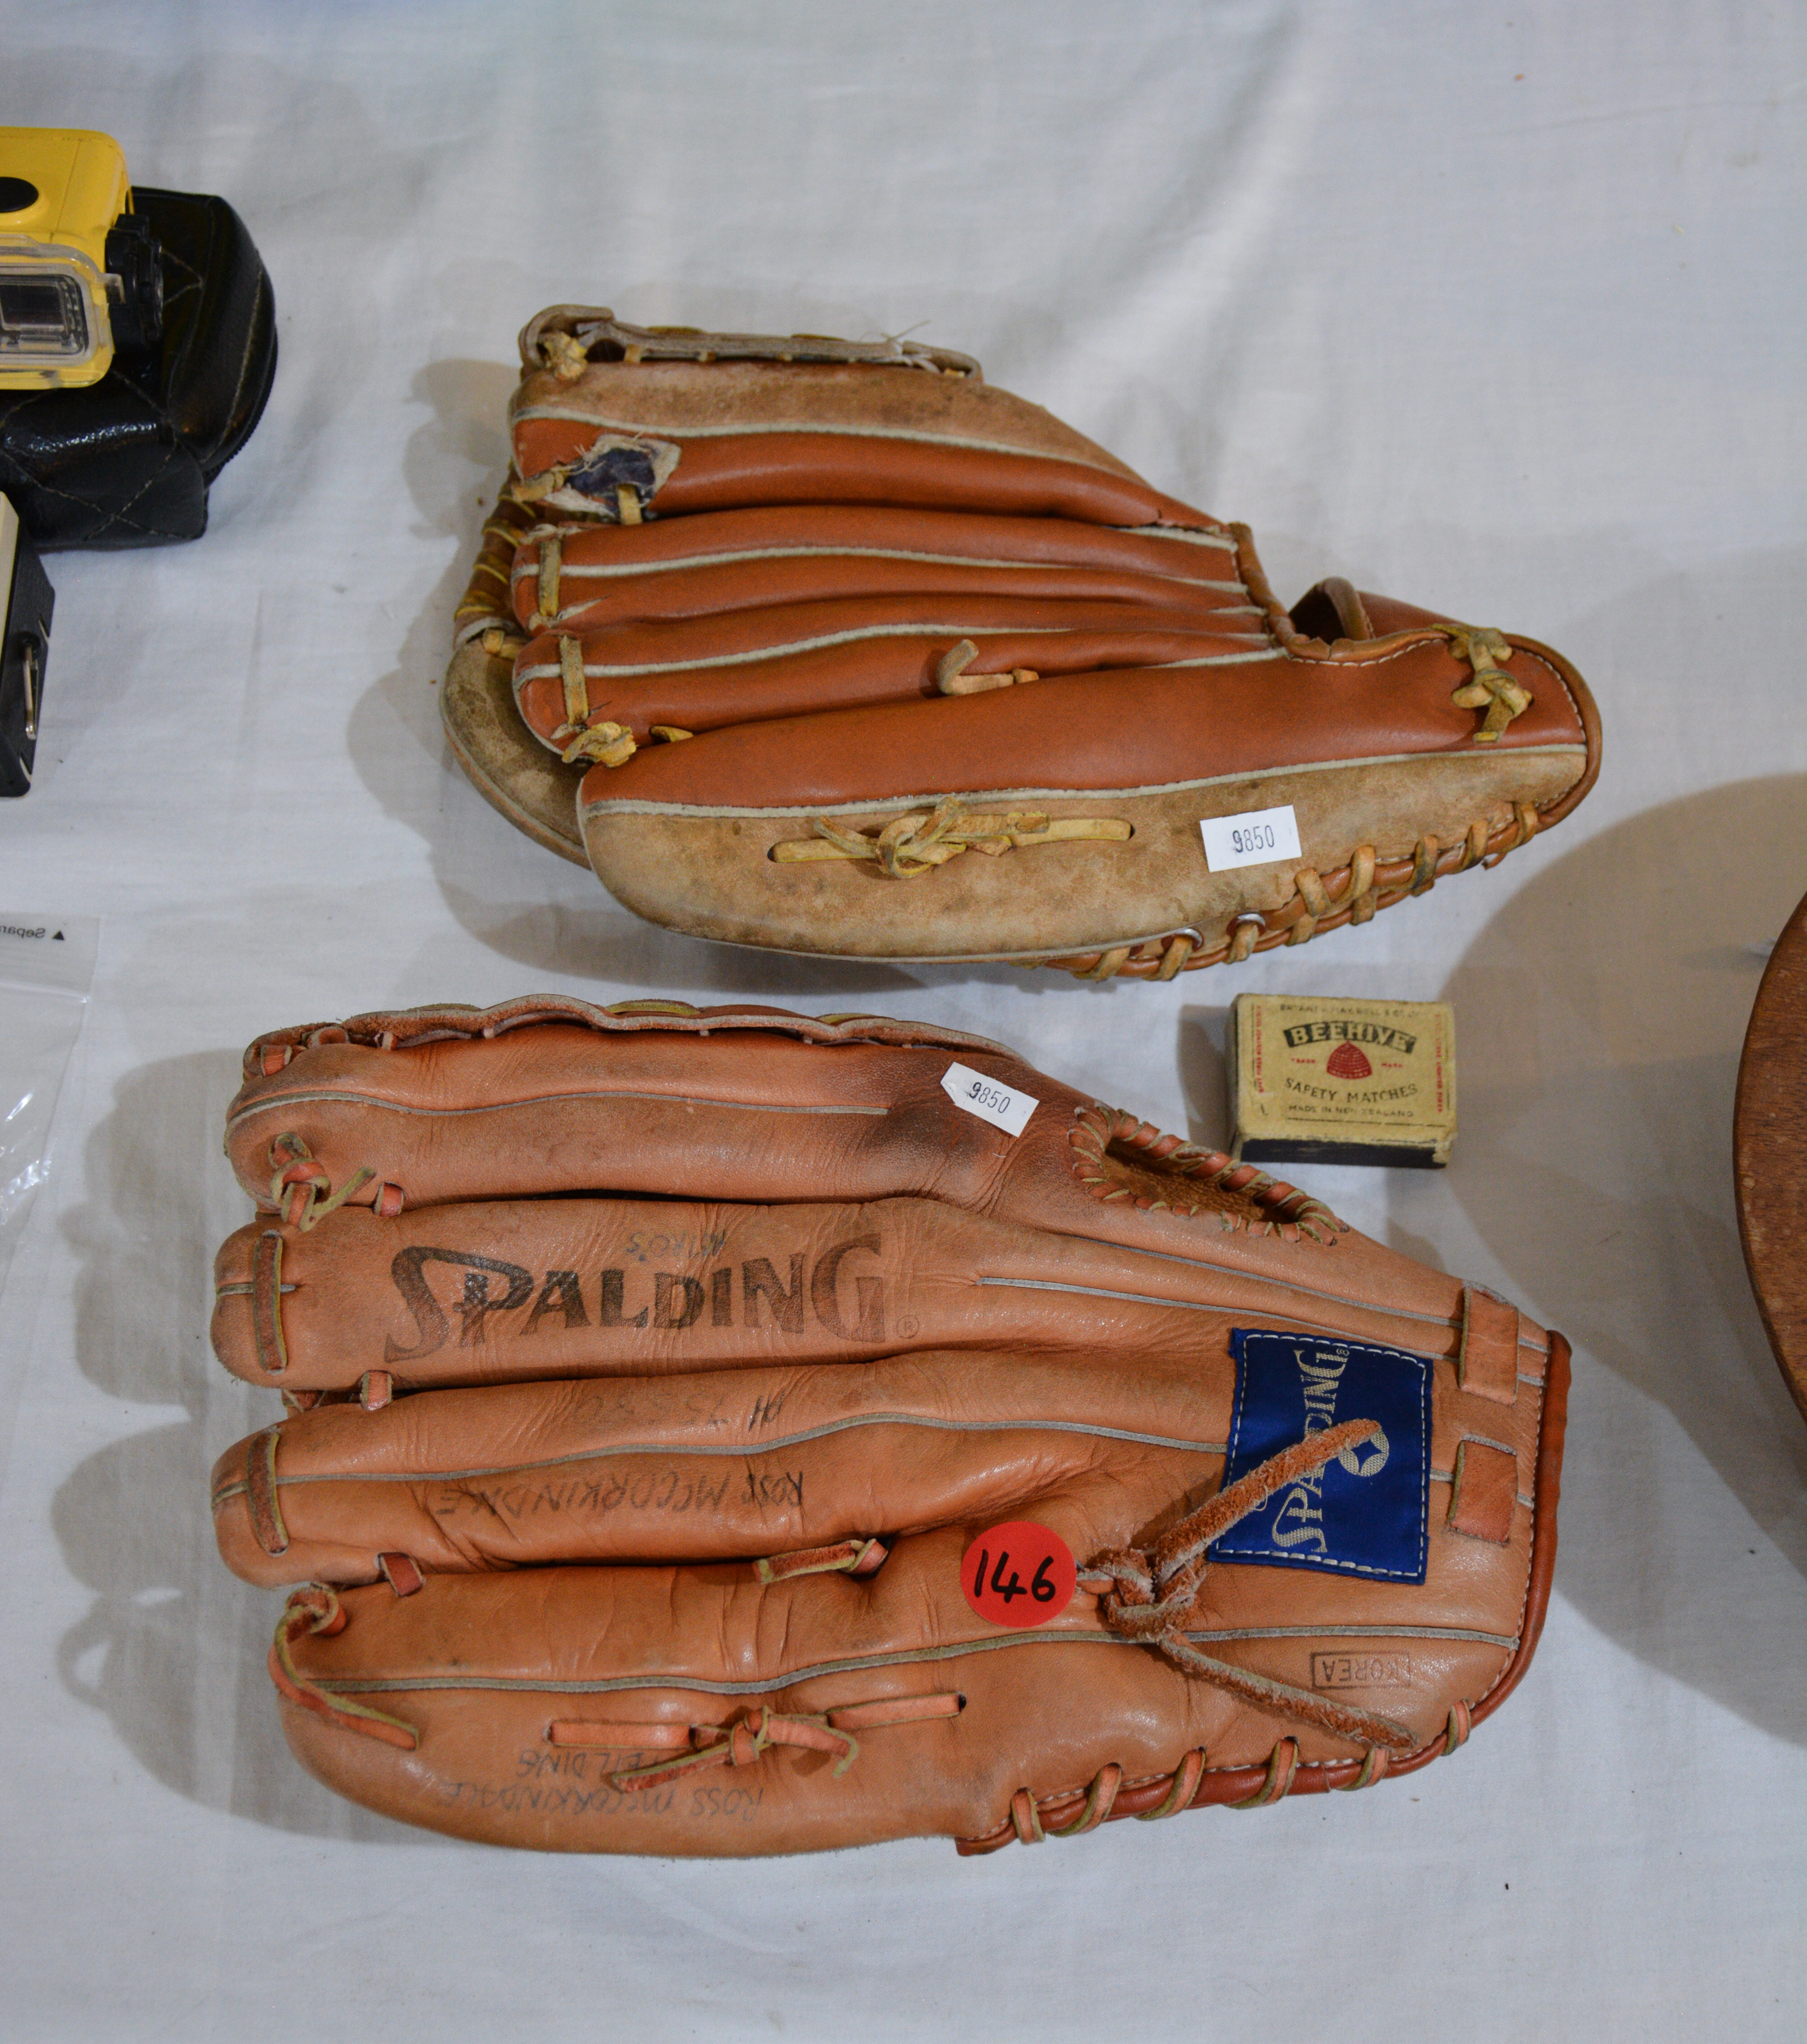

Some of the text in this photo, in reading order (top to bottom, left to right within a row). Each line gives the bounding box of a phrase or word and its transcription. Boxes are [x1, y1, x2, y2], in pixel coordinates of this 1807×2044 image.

[1232, 825, 1274, 853] 9850
[1288, 1022, 1409, 1052] BEEHIVE
[969, 1081, 1011, 1114] 9850
[1286, 1077, 1418, 1103] SAFETY MATCHES
[384, 1233, 885, 1362] SPALDING
[1272, 1350, 1348, 1553] SPADING
[974, 1549, 1055, 1603] 146
[1322, 1656, 1400, 1682] KOREA
[692, 1782, 764, 1821] ROSS
